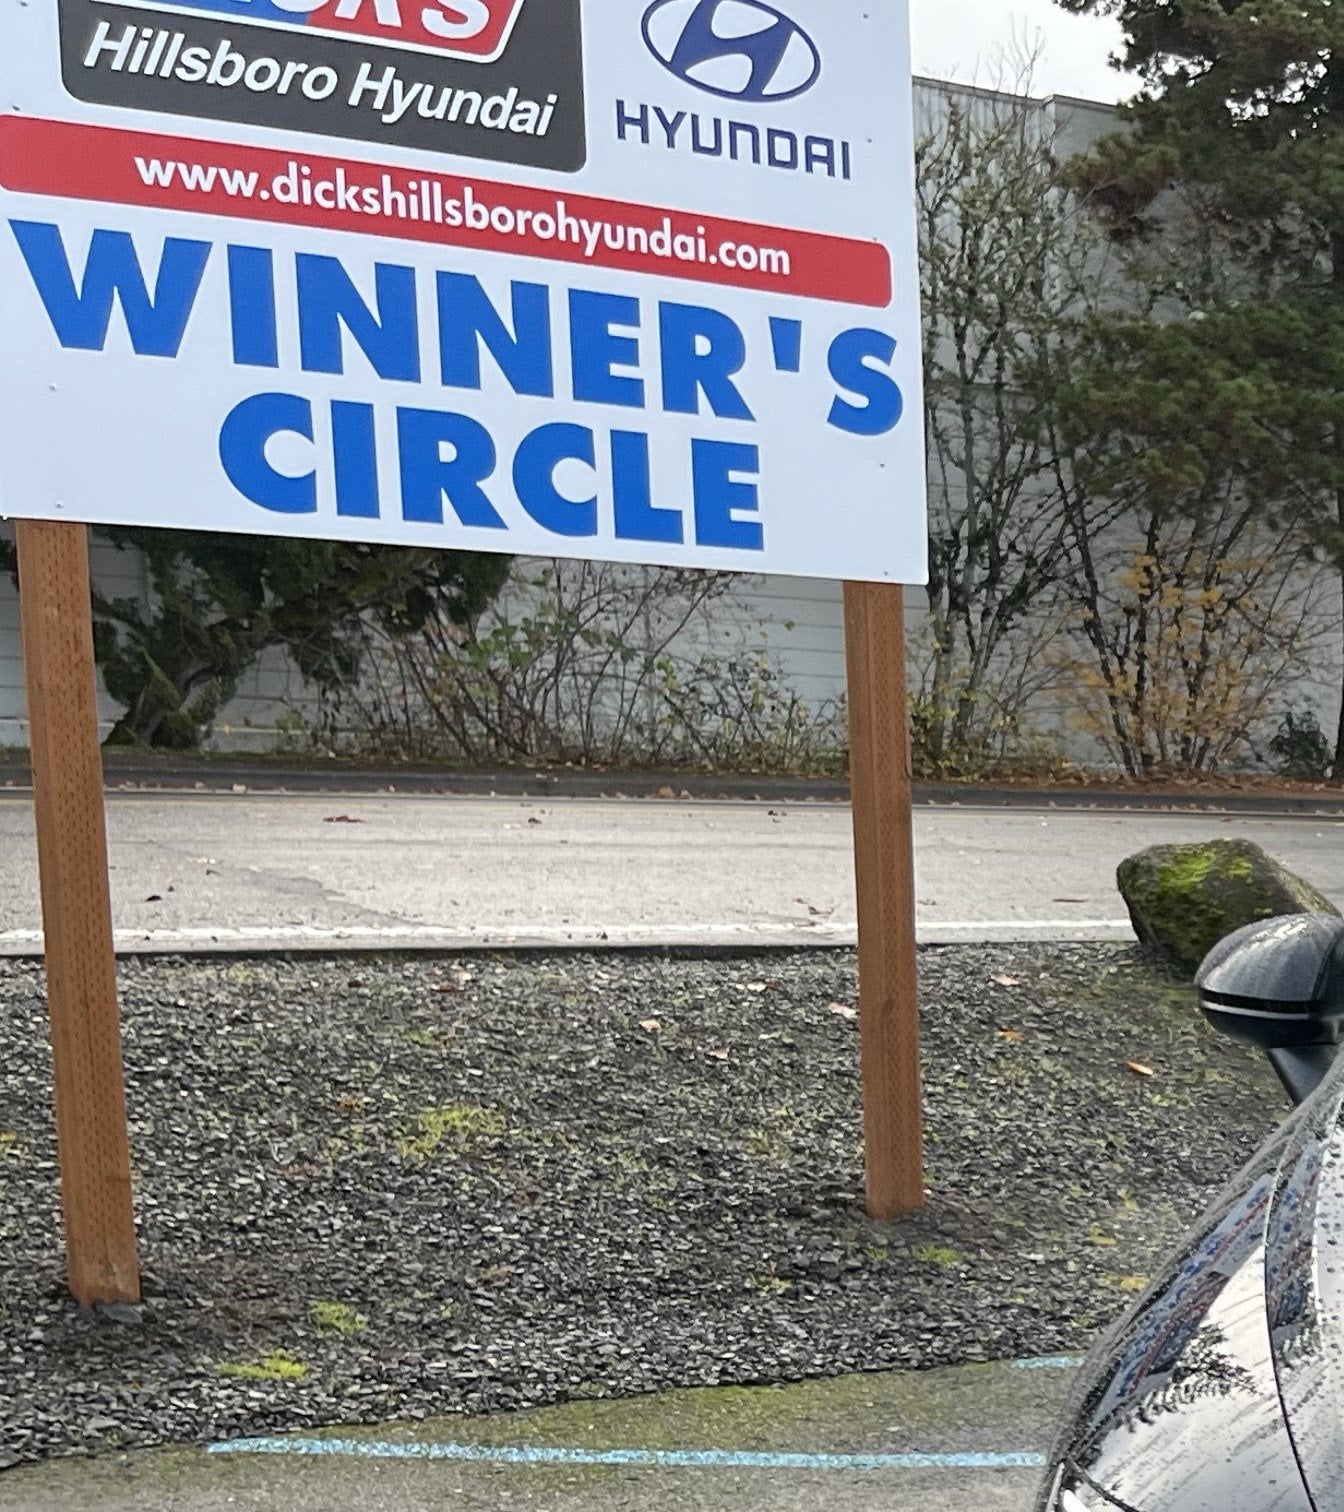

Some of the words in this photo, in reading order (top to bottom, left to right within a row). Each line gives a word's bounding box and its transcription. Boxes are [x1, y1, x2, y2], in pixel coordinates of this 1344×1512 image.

[84, 21, 338, 100] Hillsboro
[348, 62, 557, 137] Hyundai
[617, 99, 851, 181] HYUNDAI
[134, 153, 790, 276] www.dickshillsborohyundai.com
[9, 219, 904, 436] WINNER'S
[218, 392, 765, 550] CIRCLE
